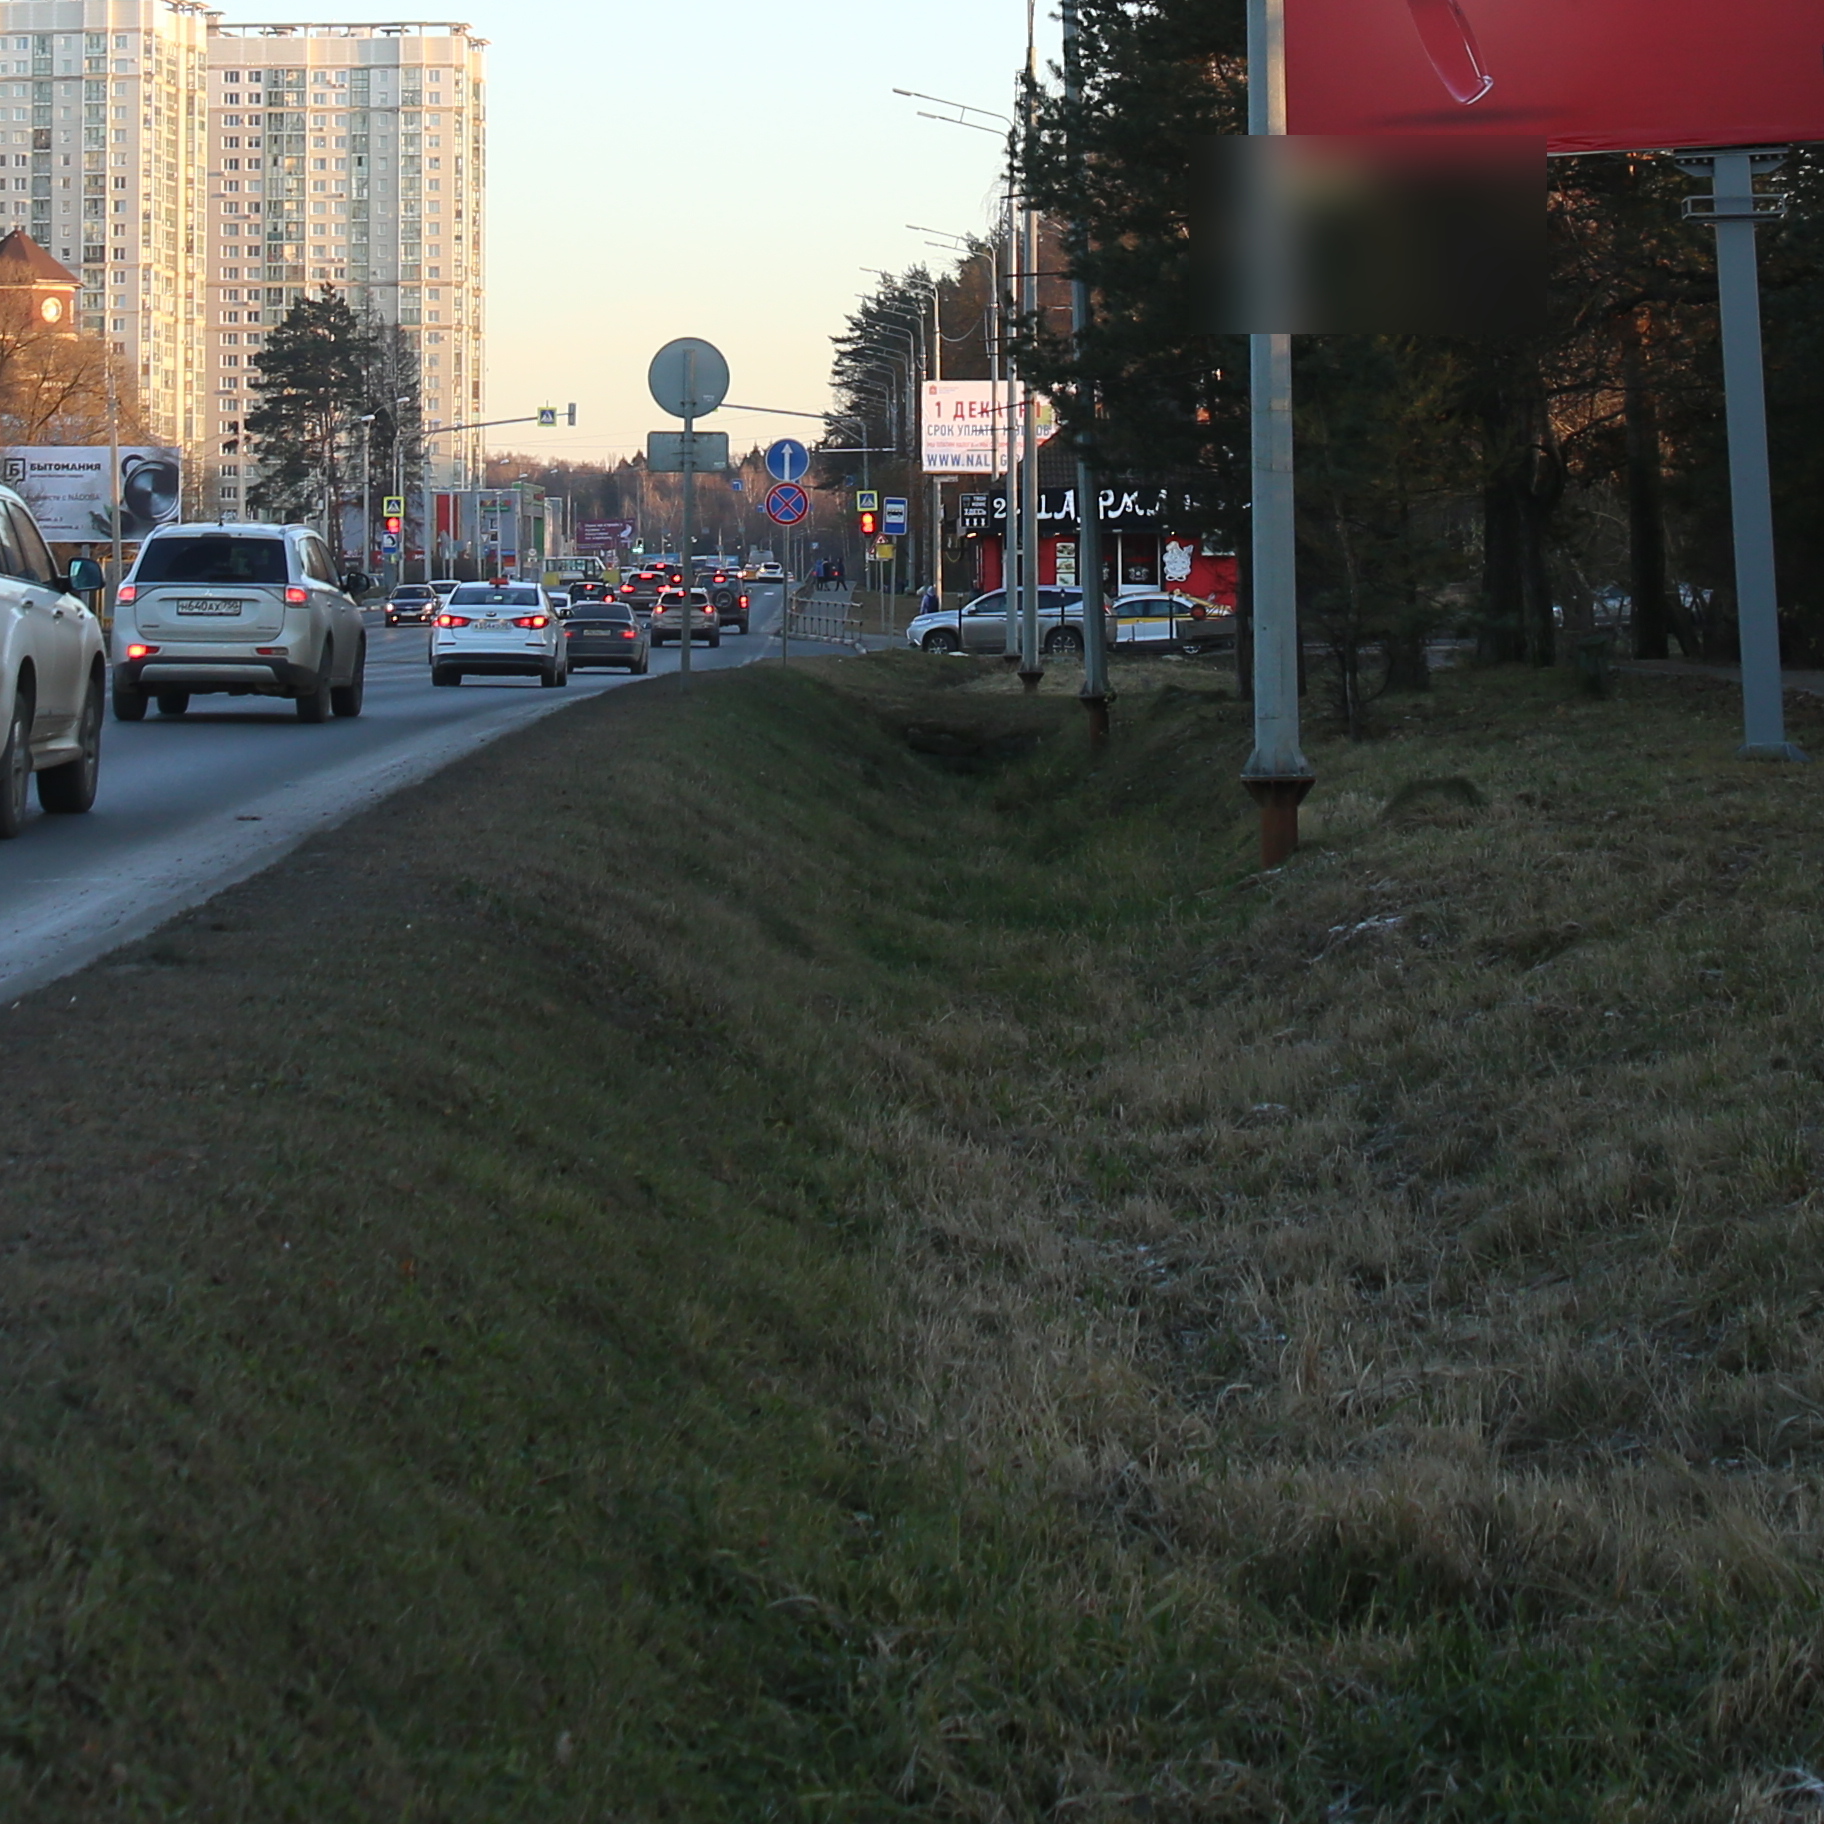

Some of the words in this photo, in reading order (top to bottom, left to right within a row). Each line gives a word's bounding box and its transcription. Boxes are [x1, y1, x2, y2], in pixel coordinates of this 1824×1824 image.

[935, 400, 942, 418] 1
[927, 425, 954, 436] СРОК
[957, 424, 994, 436] УПЛАТ
[30, 463, 101, 471] БЫТОМАНИЯ
